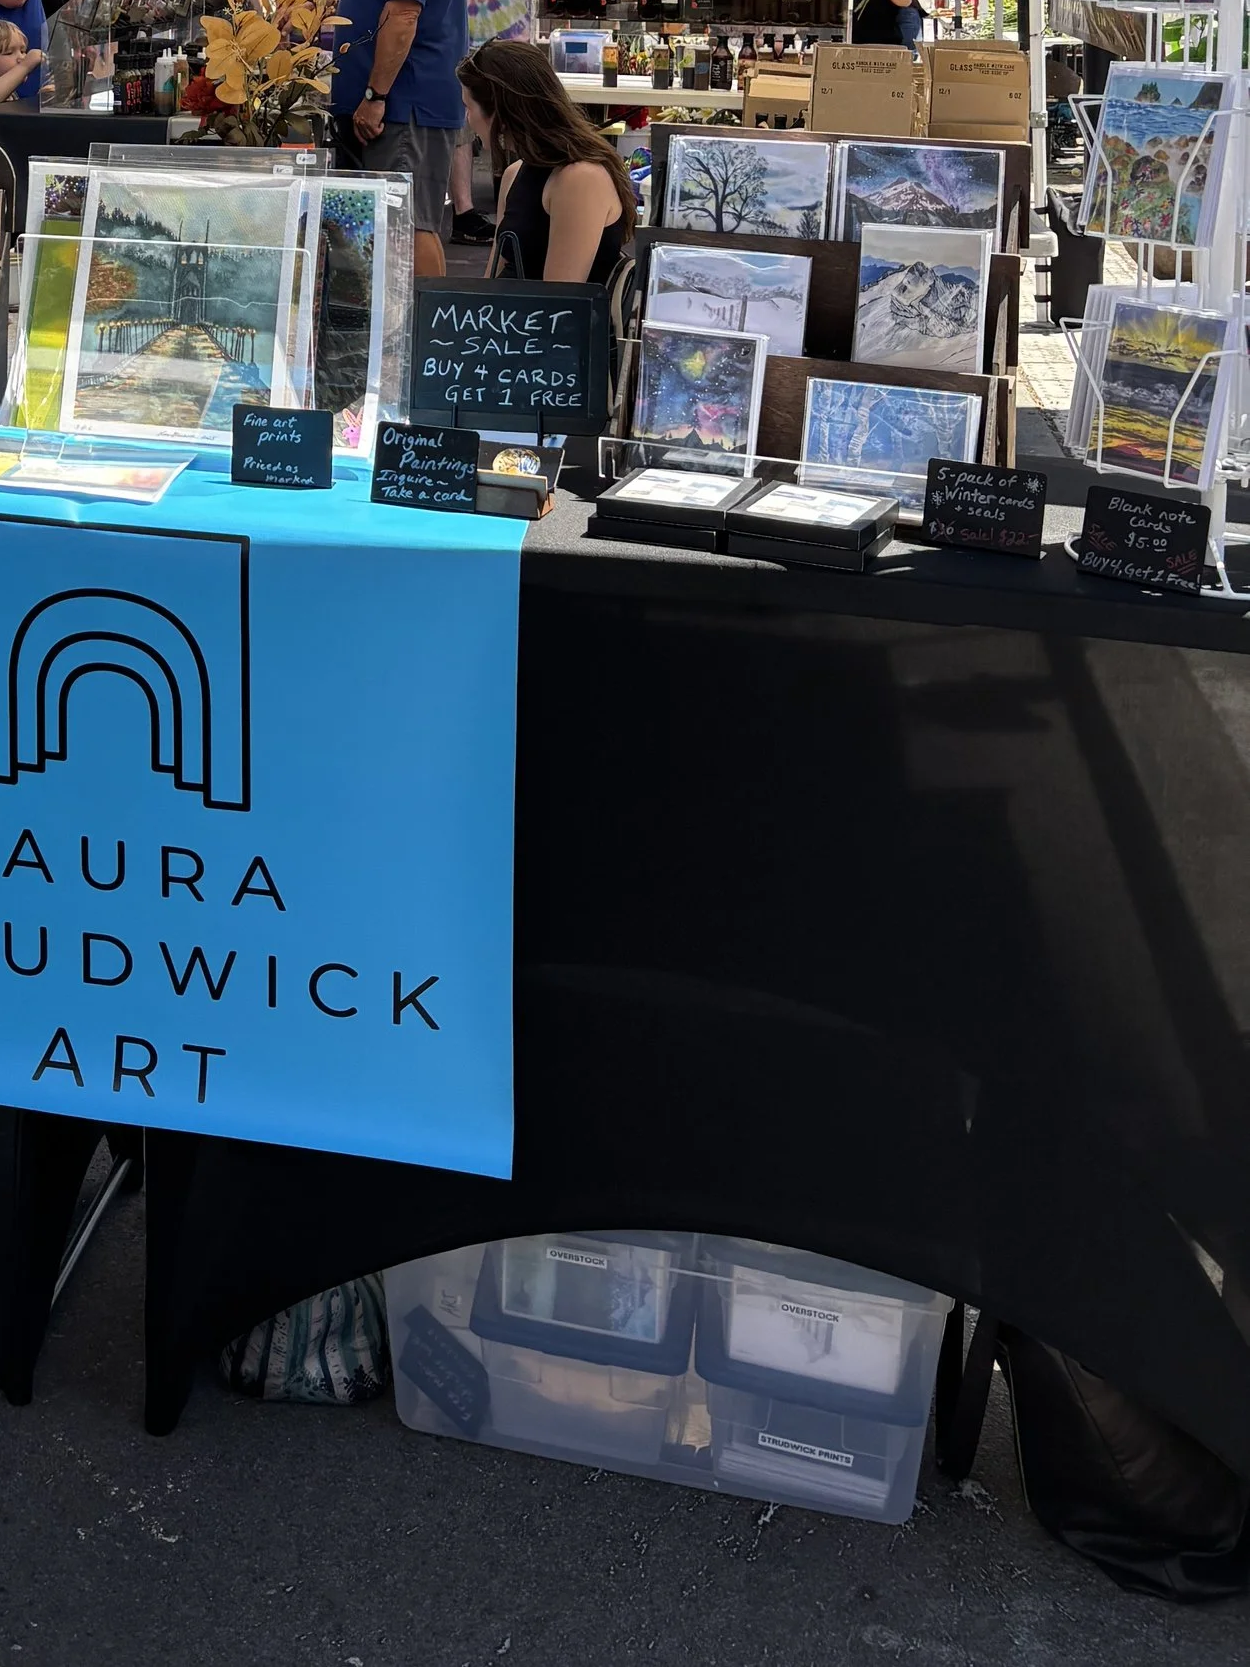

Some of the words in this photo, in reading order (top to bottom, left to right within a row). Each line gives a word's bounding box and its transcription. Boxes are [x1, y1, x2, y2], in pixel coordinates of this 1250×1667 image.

[832, 62, 856, 70] GLASS
[950, 63, 973, 72] GLASS
[432, 304, 573, 335] MARKET
[461, 336, 543, 355] SALE
[422, 357, 464, 380] BUY
[474, 364, 488, 380] 4
[498, 369, 576, 387] CARDS
[445, 385, 486, 403] GET
[498, 389, 513, 406] 1
[530, 390, 582, 407] FREE
[243, 413, 267, 426] Fine
[273, 416, 297, 428] art
[257, 430, 301, 446] prints
[383, 427, 443, 451] Original
[243, 456, 282, 472] Priced
[285, 464, 298, 474] as
[399, 451, 475, 479] Paintings
[937, 467, 994, 487] 5-pack
[998, 475, 1018, 487] of
[381, 485, 413, 498] Take
[418, 491, 430, 499] a
[433, 489, 472, 502] card
[944, 485, 997, 504] Winter
[967, 507, 1005, 521] seals
[1108, 497, 1153, 515] Blank
[1159, 510, 1196, 524] note
[1124, 563, 1153, 580] Get
[31, 1026, 227, 1104] ART
[550, 1249, 605, 1267] OVERSTOCK
[781, 1303, 839, 1323] OVERSTOCK
[760, 1435, 817, 1456] STRUDWICK
[818, 1450, 853, 1465] PRINTS
